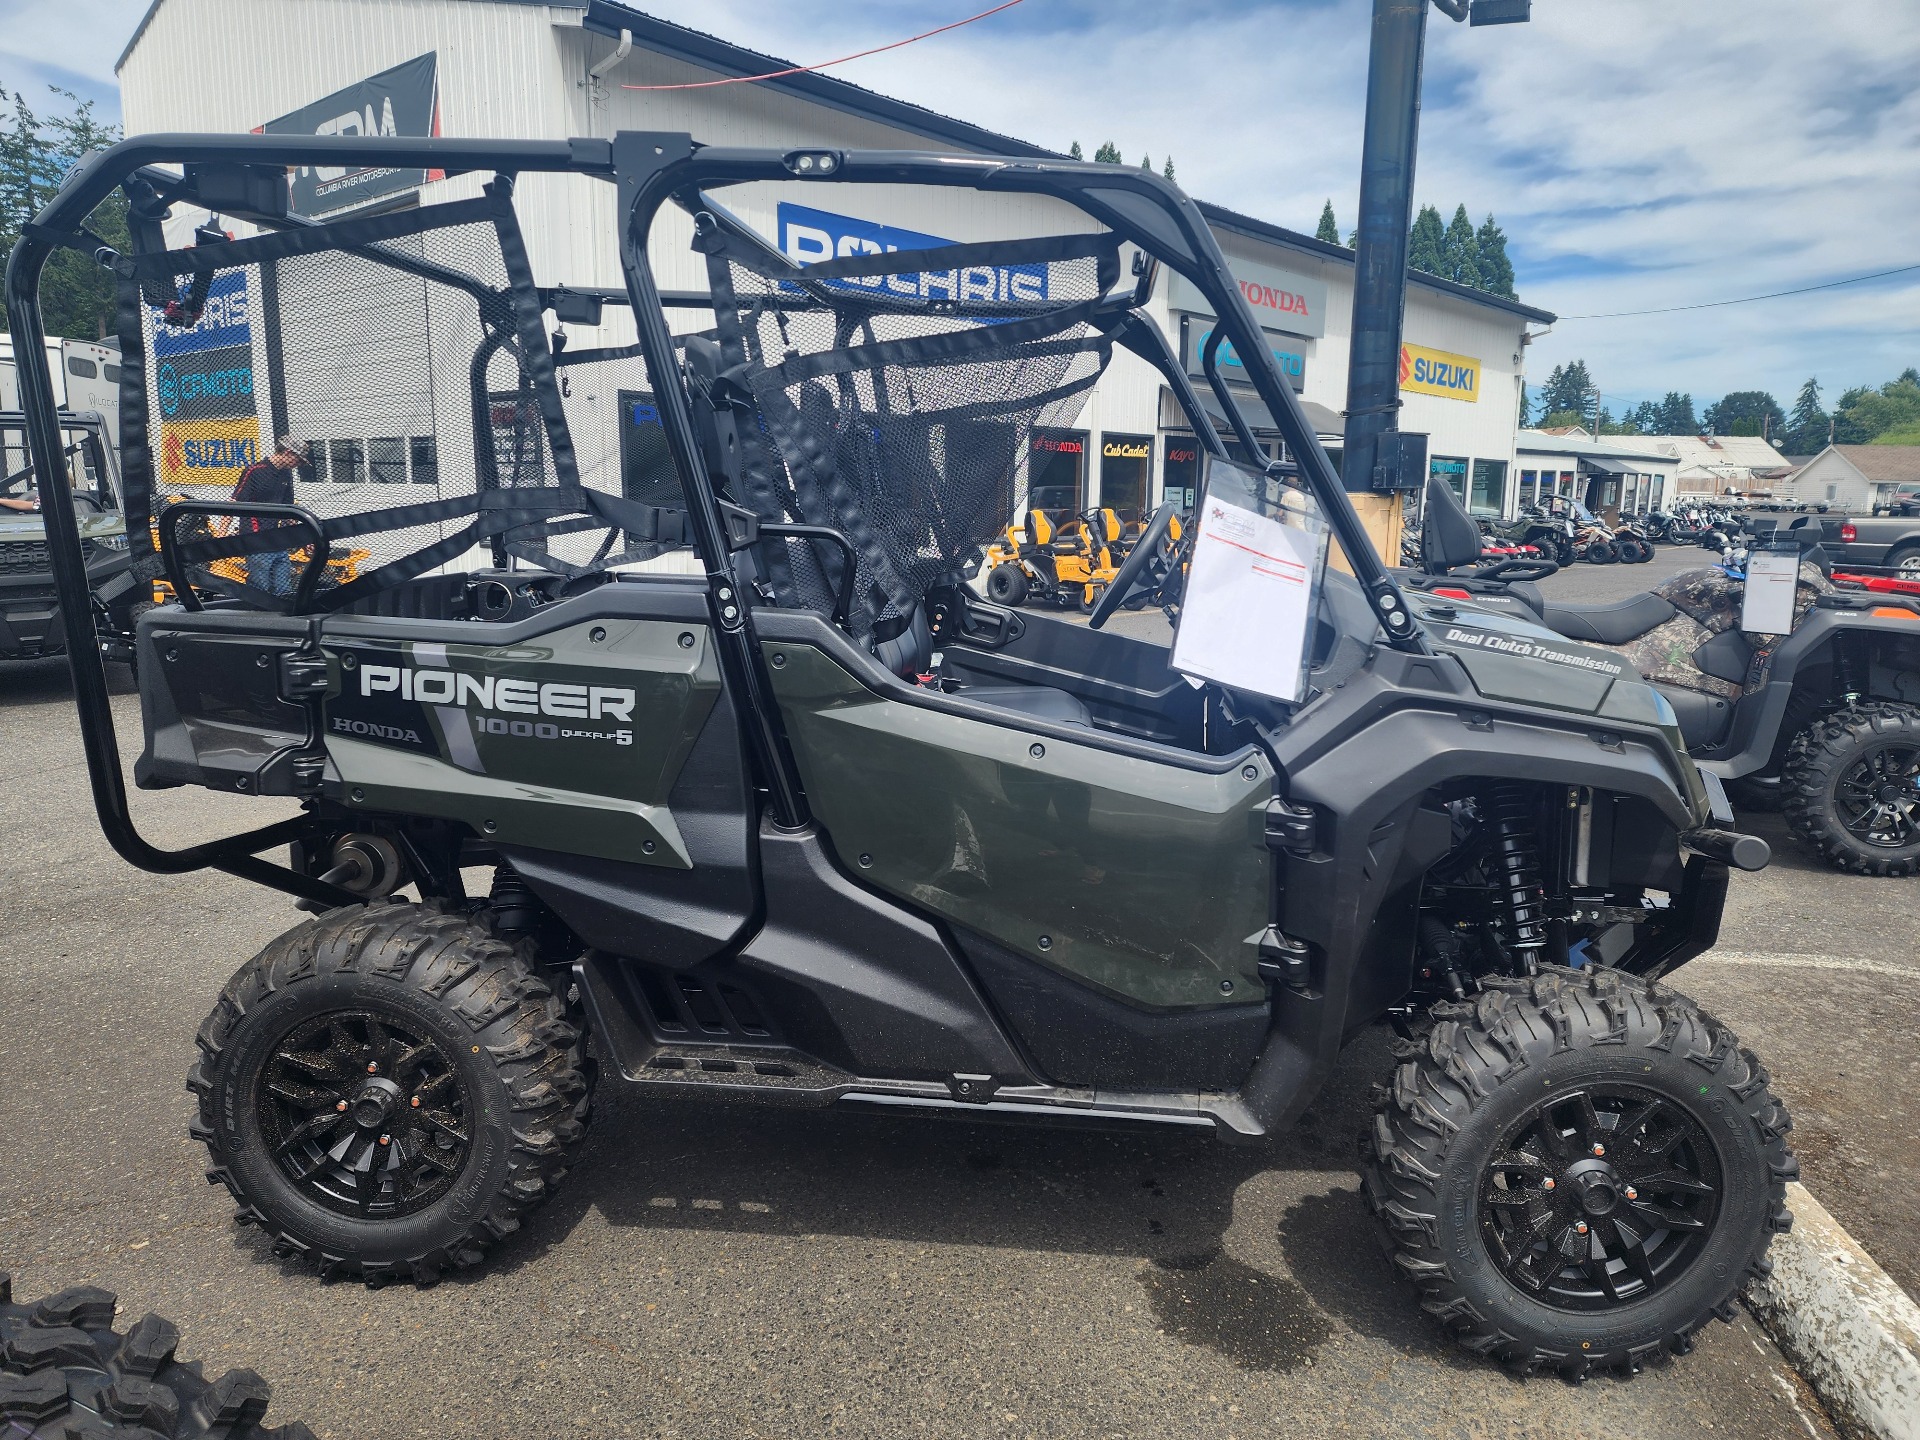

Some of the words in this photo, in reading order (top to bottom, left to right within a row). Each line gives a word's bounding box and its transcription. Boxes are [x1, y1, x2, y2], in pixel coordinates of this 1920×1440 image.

[315, 182, 343, 196] COLUMBIA
[342, 176, 359, 190] RIVER
[153, 291, 249, 341] PRIS
[1414, 357, 1474, 392] SUZUKI
[183, 438, 256, 468] SUZUKI
[1103, 443, 1121, 457] Cub
[1121, 444, 1149, 457] Cadet
[1446, 628, 1485, 645] Dual
[1484, 636, 1532, 655] Clutch
[1533, 645, 1622, 675] Transmission
[360, 664, 636, 722] PIONEER
[333, 717, 422, 744] HONDA
[475, 715, 559, 740] 1000
